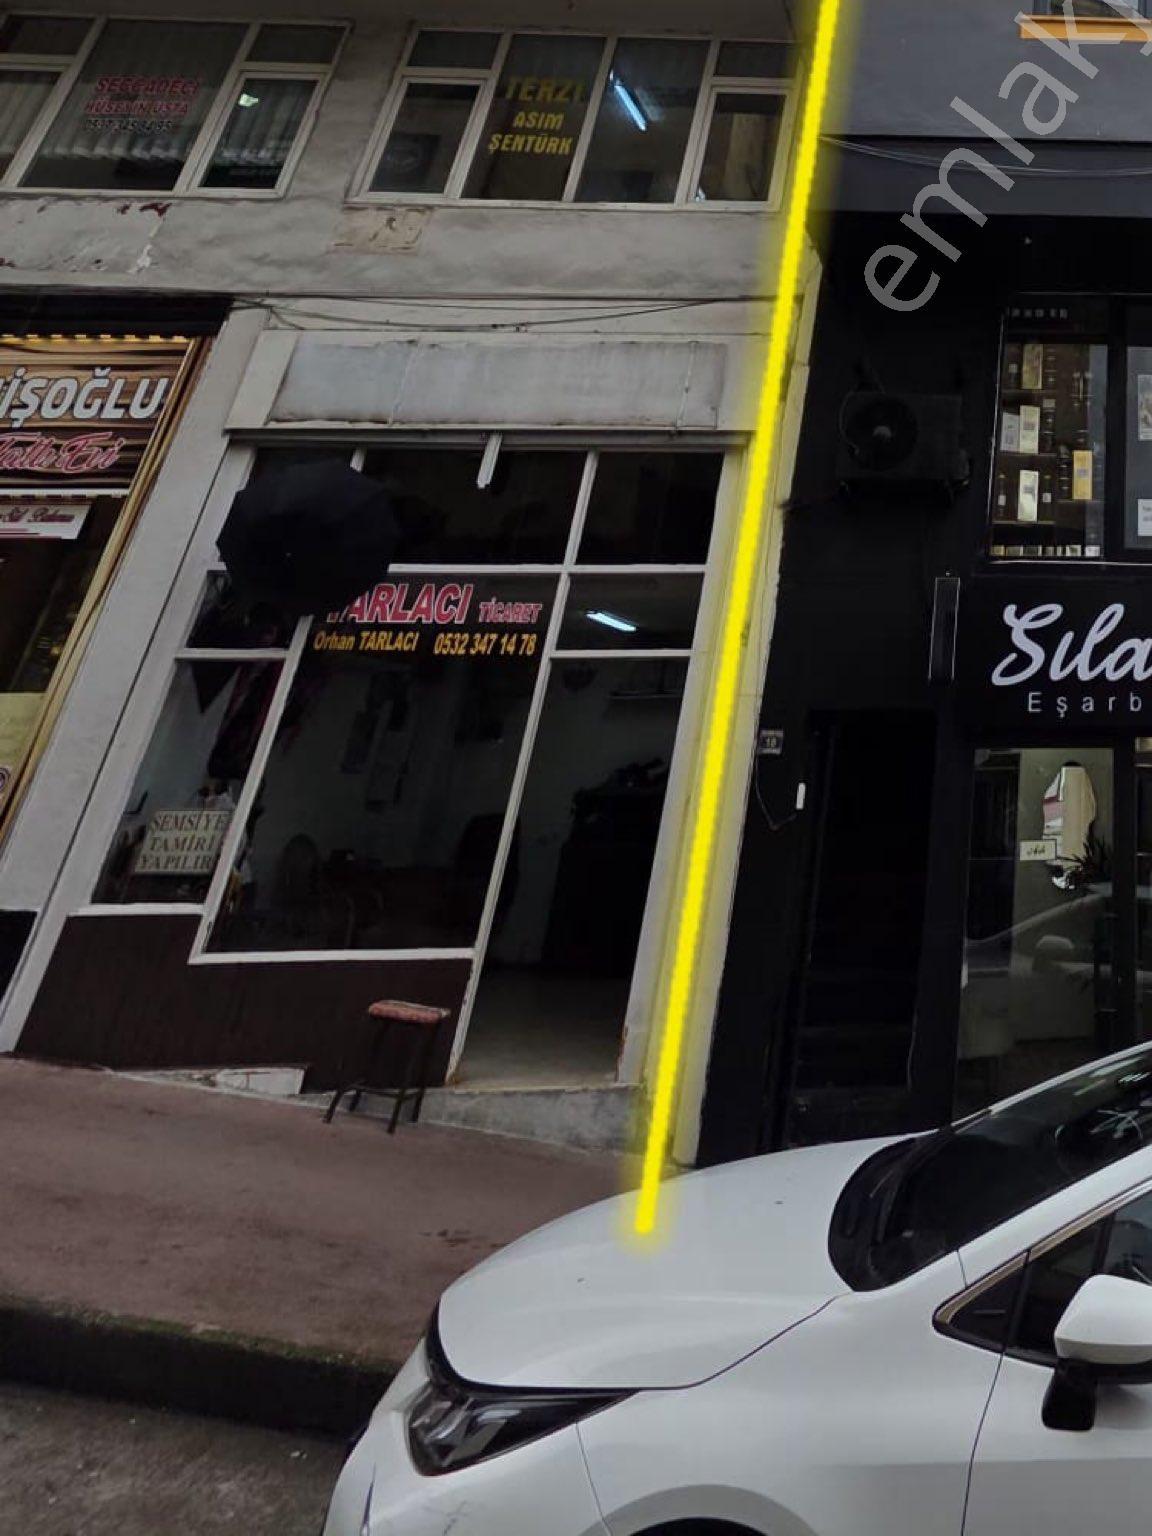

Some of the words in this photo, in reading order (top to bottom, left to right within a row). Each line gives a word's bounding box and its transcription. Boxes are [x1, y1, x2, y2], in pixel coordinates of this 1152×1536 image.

[513, 111, 564, 130] ASIM
[488, 133, 573, 155] ŞENTÜRK
[0, 367, 169, 428] İŞOĞLU
[327, 583, 474, 624] ARLACI
[479, 596, 543, 623] TİCARET
[313, 630, 355, 652] Orhan
[358, 630, 419, 651] TARLACI
[433, 632, 467, 655] 0532
[469, 632, 498, 655] 347
[500, 633, 517, 655] 14
[518, 633, 538, 656] 78
